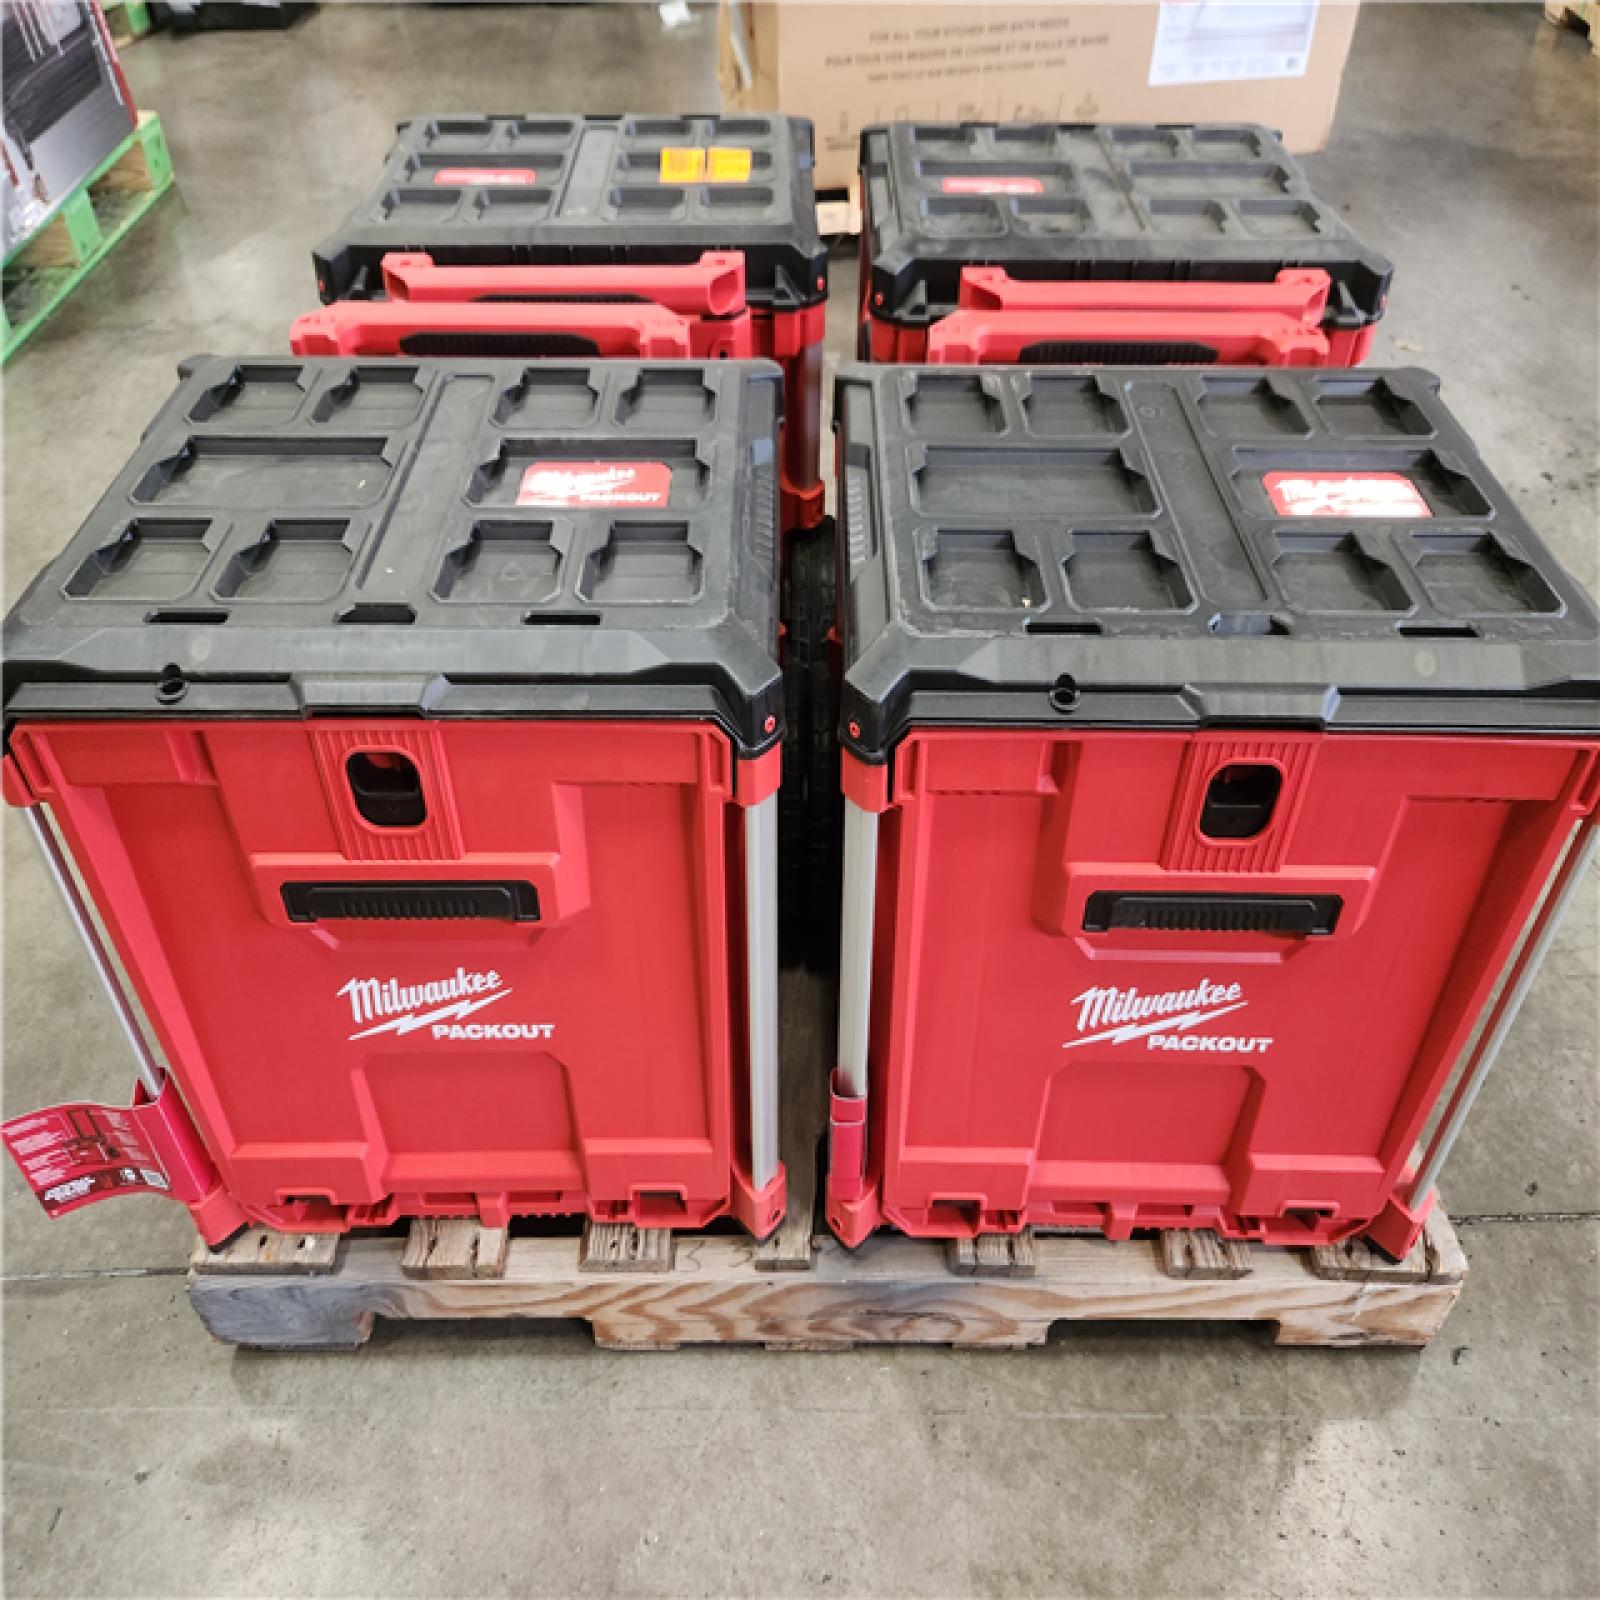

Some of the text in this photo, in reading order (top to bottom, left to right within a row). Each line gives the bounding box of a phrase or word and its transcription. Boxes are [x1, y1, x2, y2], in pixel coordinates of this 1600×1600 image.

[337, 967, 503, 1023] Milwaukee
[1070, 977, 1241, 1032] Milwaukee
[431, 1024, 555, 1040] PACKOUT
[1147, 1034, 1273, 1052] PACKOUT
